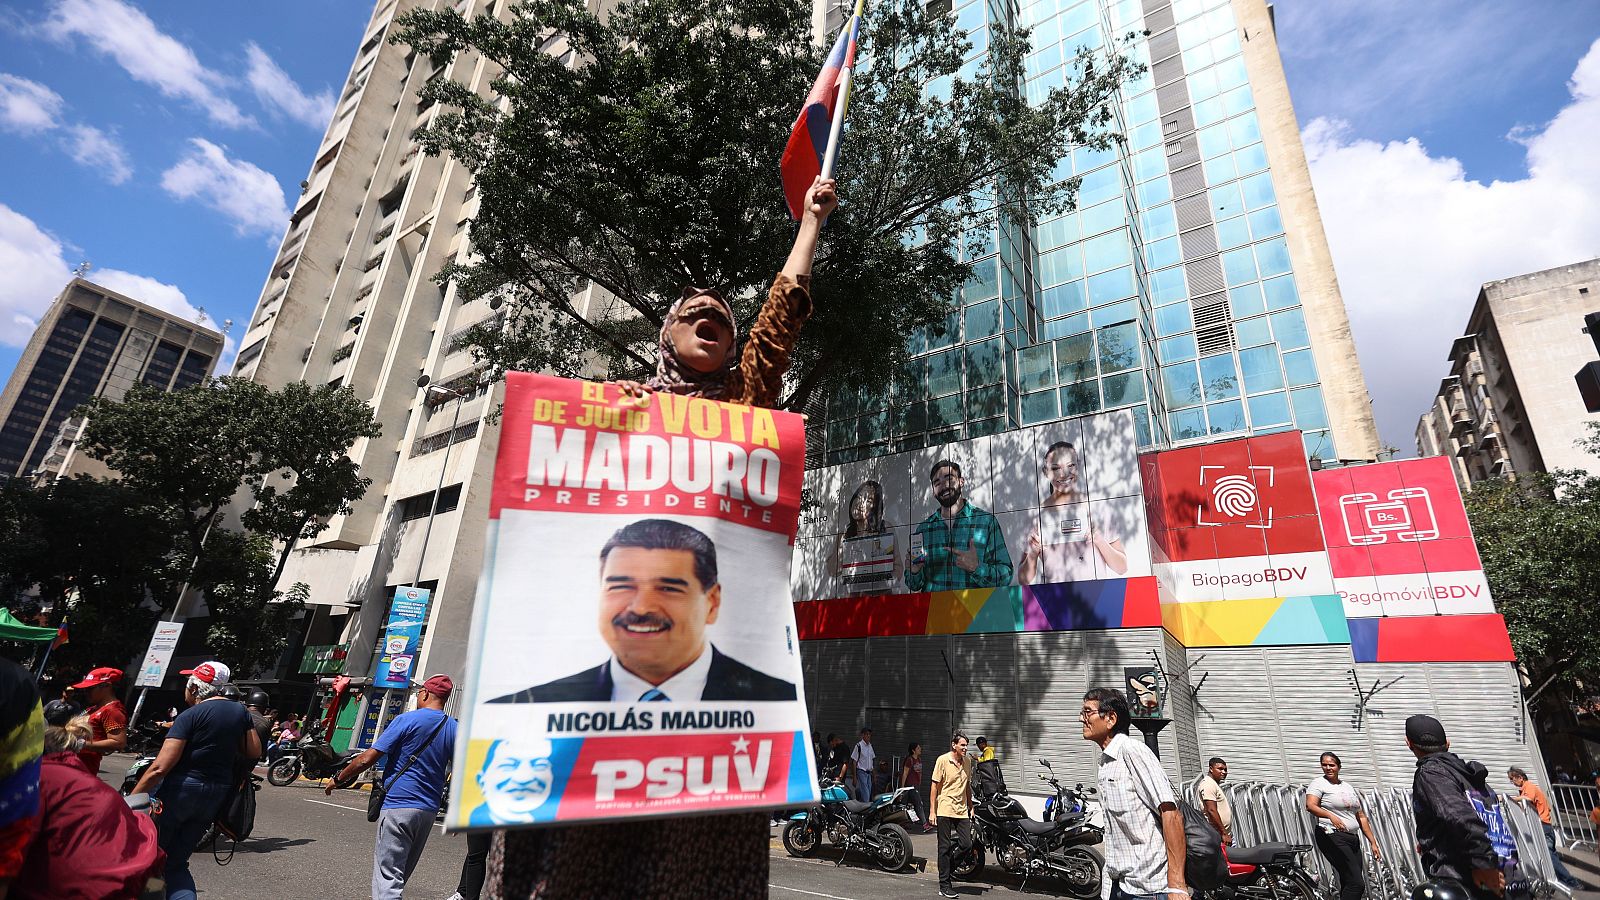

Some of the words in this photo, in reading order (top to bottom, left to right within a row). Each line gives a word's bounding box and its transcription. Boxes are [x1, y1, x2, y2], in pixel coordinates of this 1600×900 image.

[582, 380, 609, 404] EL
[533, 399, 567, 425] DE
[575, 403, 651, 433] JULIO
[656, 392, 780, 450] VOTA
[525, 424, 781, 507] MADURO
[524, 490, 772, 524] PRESIDENTE
[803, 516, 828, 525] Banco
[1377, 512, 1398, 522] Bs.
[547, 707, 653, 732] NICOLÁS
[661, 710, 755, 730] MADURO
